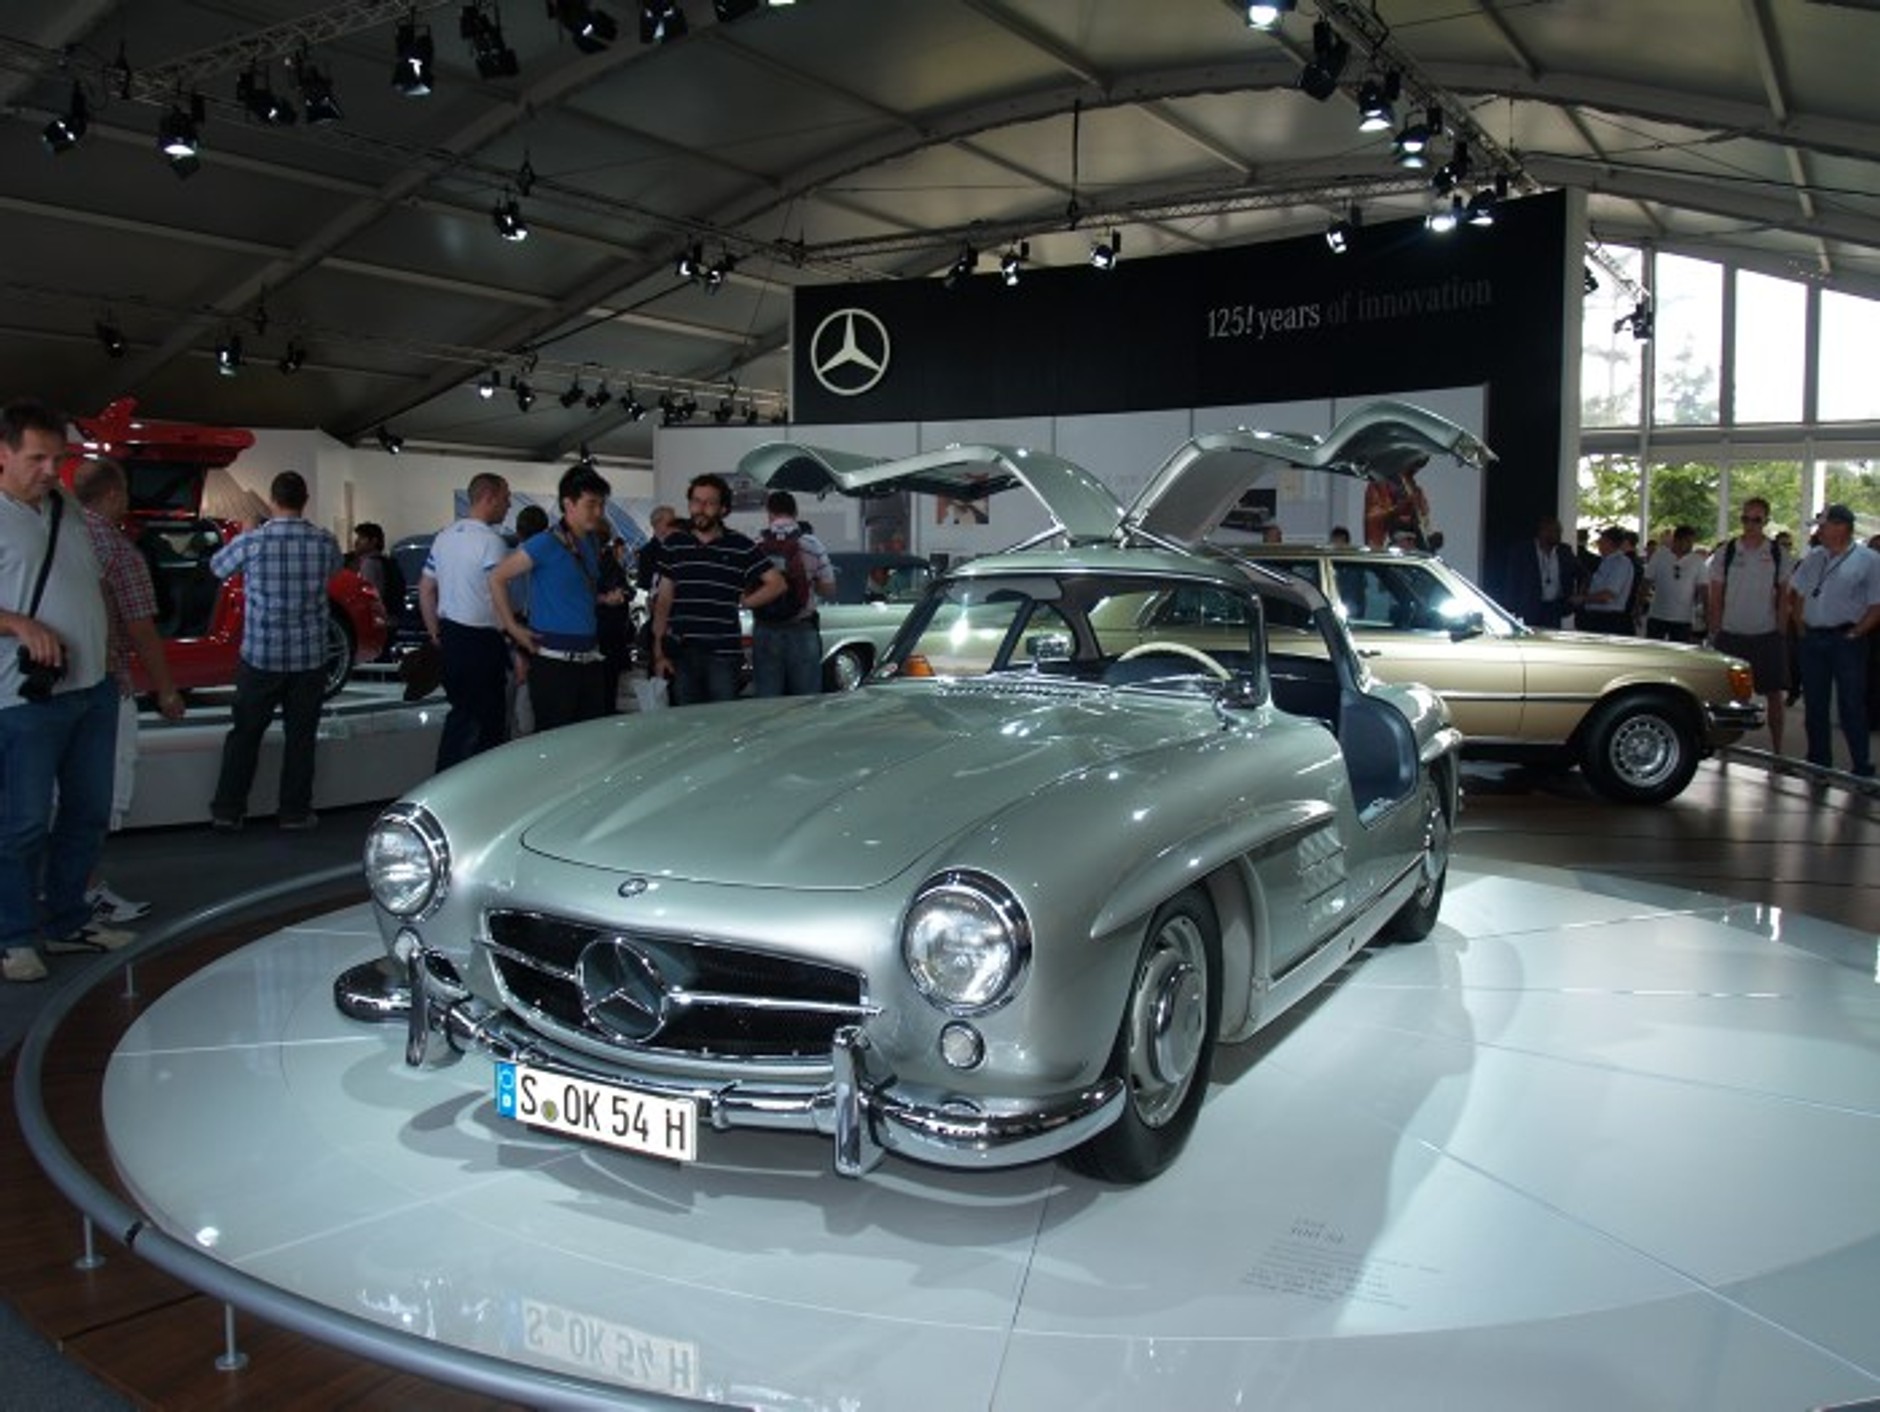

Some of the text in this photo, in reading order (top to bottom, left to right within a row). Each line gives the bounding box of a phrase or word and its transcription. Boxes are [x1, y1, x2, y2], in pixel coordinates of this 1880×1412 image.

[1207, 276, 1493, 341] 125! years of innovation
[520, 1074, 685, 1150] S OK 54 H
